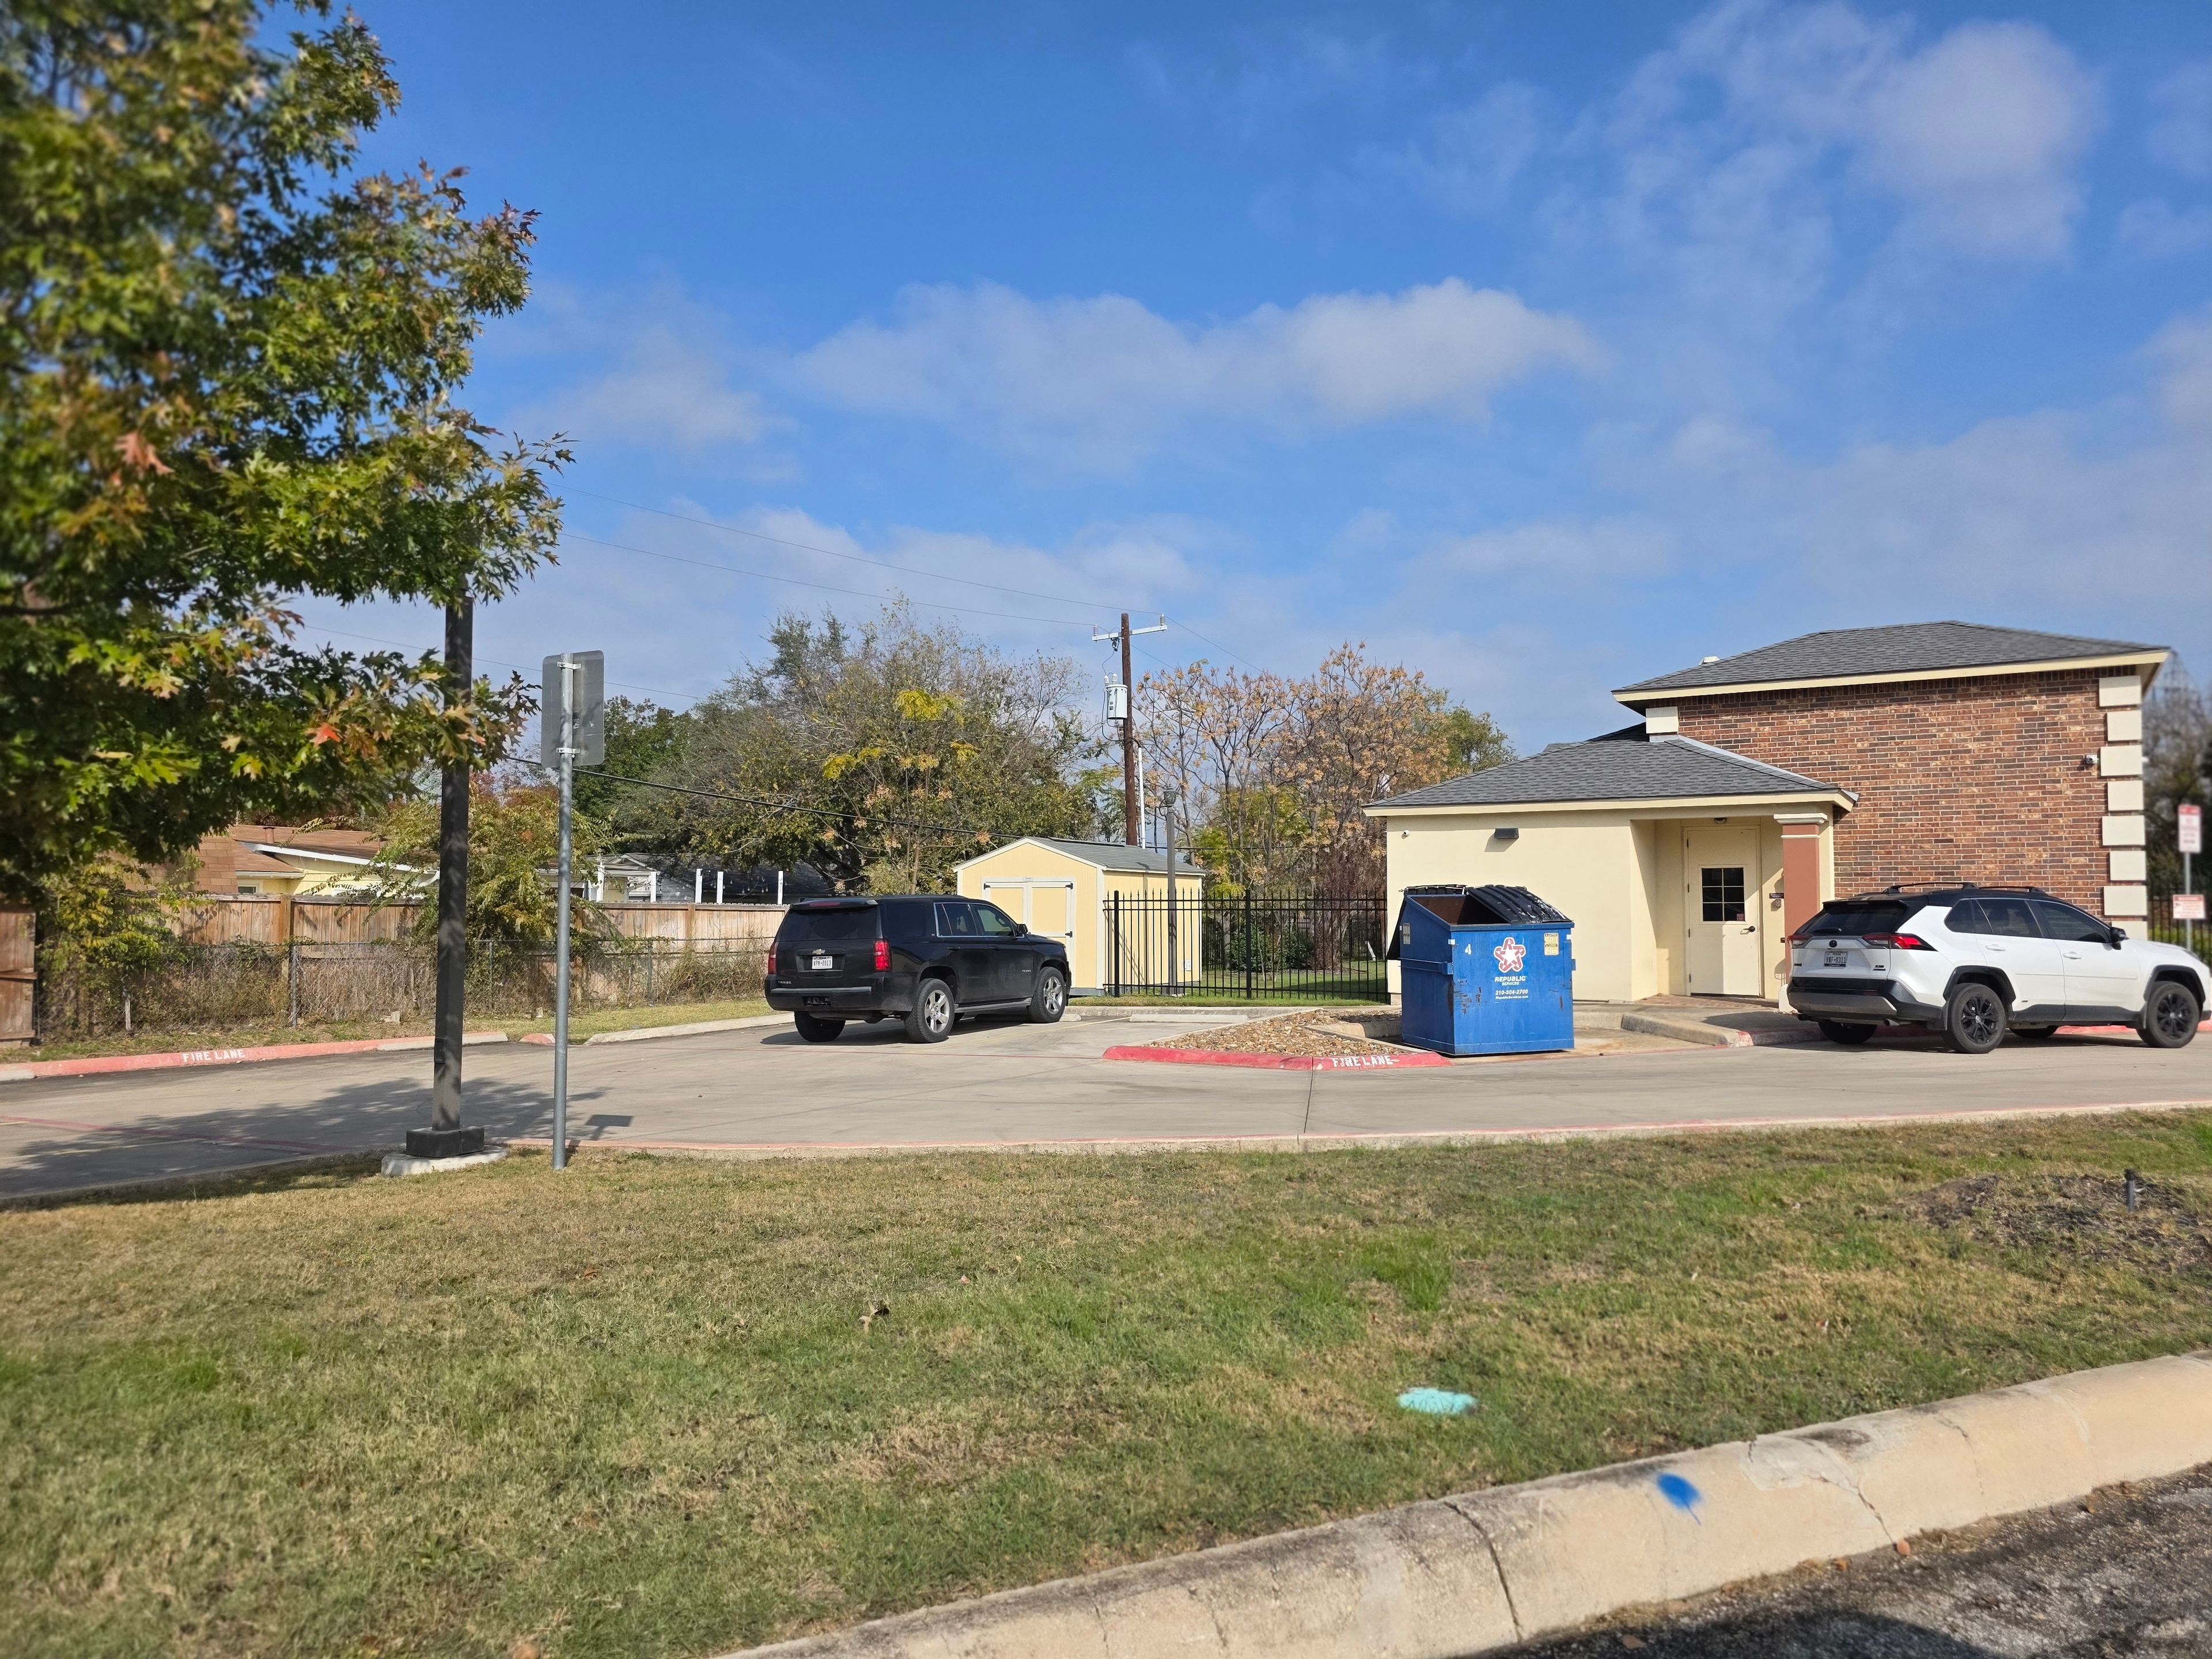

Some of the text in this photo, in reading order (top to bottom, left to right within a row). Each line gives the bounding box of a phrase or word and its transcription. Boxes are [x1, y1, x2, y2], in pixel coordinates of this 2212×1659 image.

[1465, 944, 1471, 955] 4
[182, 1052, 211, 1062] FIRE
[214, 1049, 245, 1060] LANE
[1332, 1055, 1393, 1067] FIRE LANE
